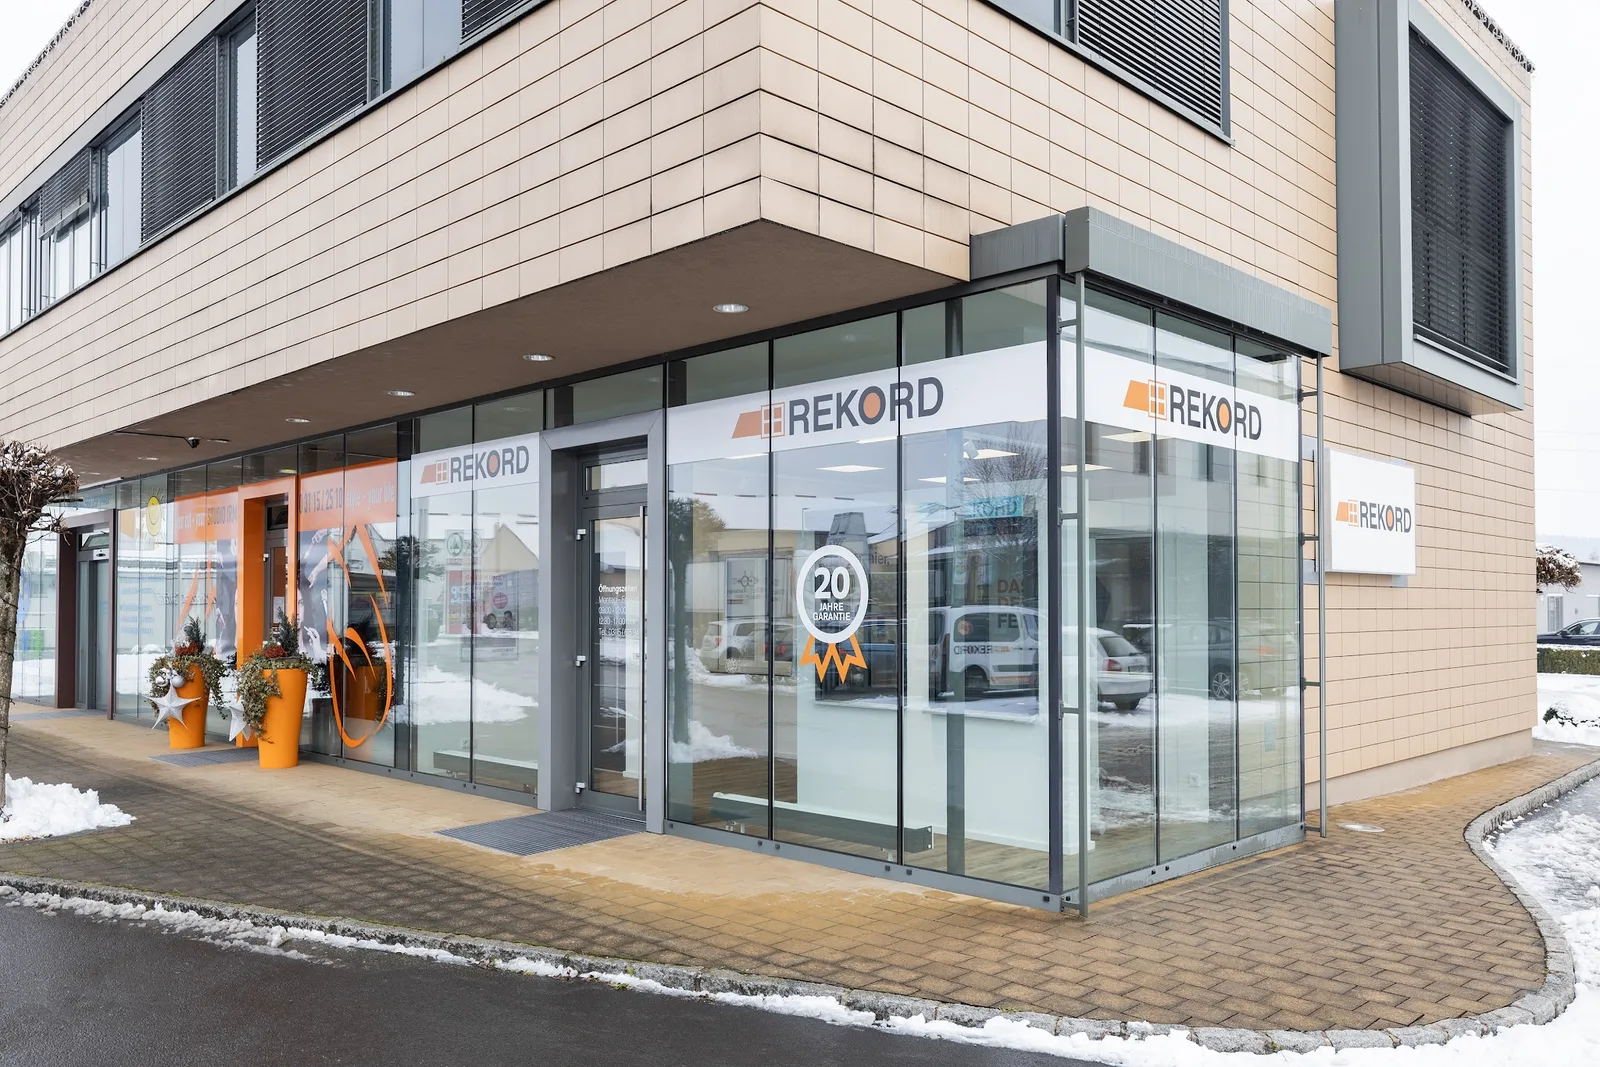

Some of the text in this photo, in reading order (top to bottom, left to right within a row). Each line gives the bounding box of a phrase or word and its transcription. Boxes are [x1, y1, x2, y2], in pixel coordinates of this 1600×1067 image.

[789, 377, 944, 436] REKORD
[1169, 384, 1262, 441] REKORD
[450, 445, 530, 484] REKORD
[207, 507, 225, 526] STUDIO
[1359, 500, 1413, 534] REKORD
[814, 566, 850, 599] 20
[812, 612, 851, 621] GARANTIE
[819, 602, 844, 611] JAHRE
